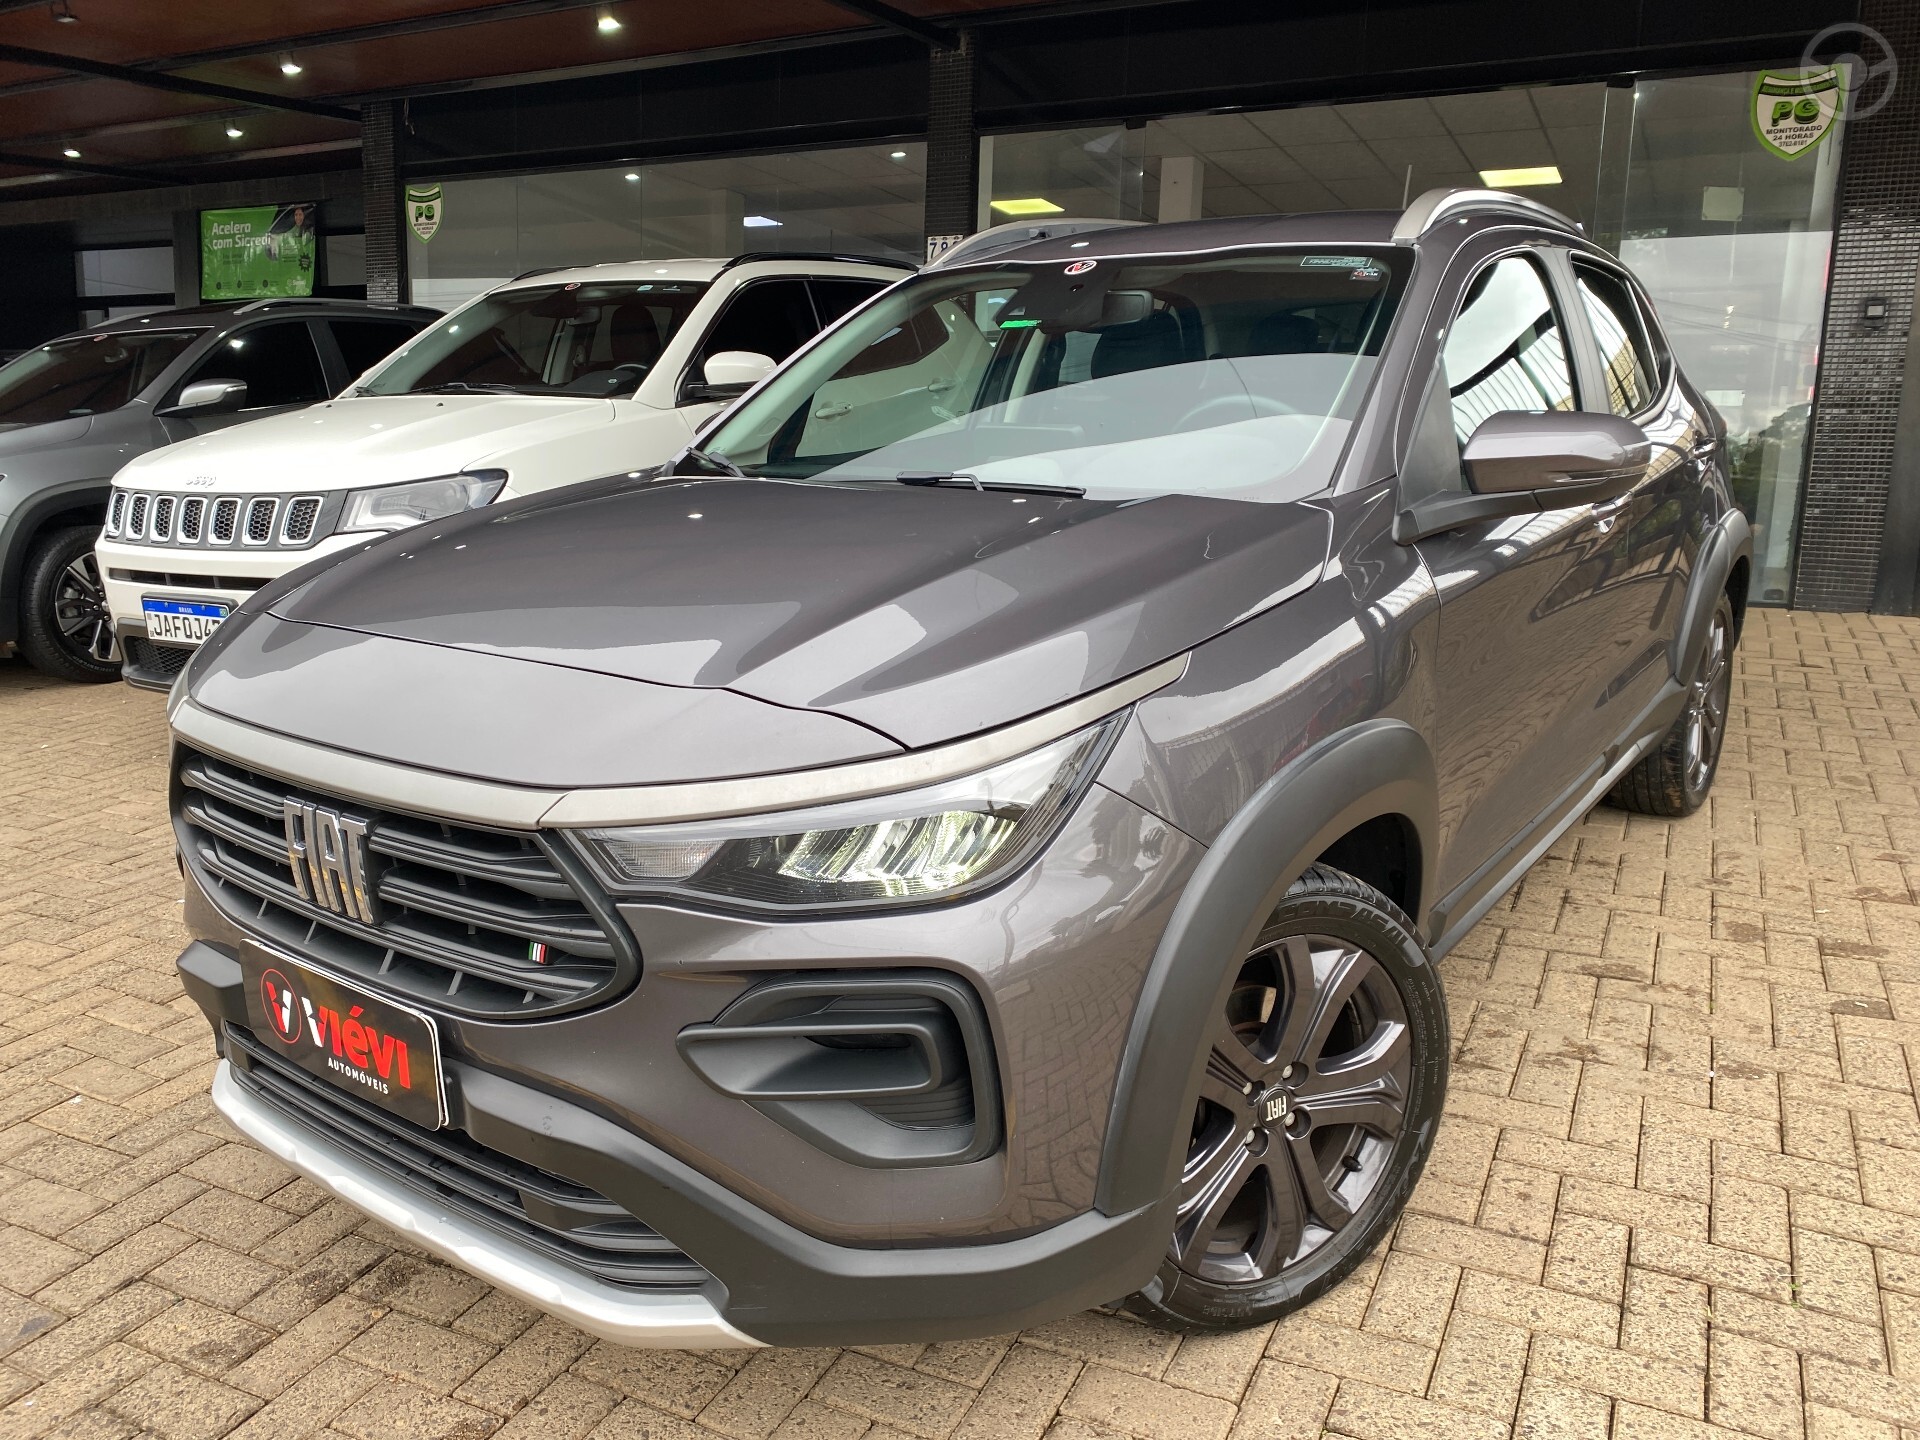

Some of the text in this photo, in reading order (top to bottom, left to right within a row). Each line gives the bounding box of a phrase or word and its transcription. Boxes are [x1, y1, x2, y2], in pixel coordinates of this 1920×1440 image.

[1771, 99, 1820, 127] PG
[1766, 125, 1822, 135] MONITORADO
[1785, 132, 1814, 140] HORAS
[211, 221, 251, 236] Acelera
[212, 233, 271, 250] com Sicredi
[178, 606, 194, 614] BRASIL
[284, 795, 374, 925] FIAT
[327, 1057, 389, 1095] AUTOMÓVEIS
[1265, 1096, 1287, 1121] FIAT
